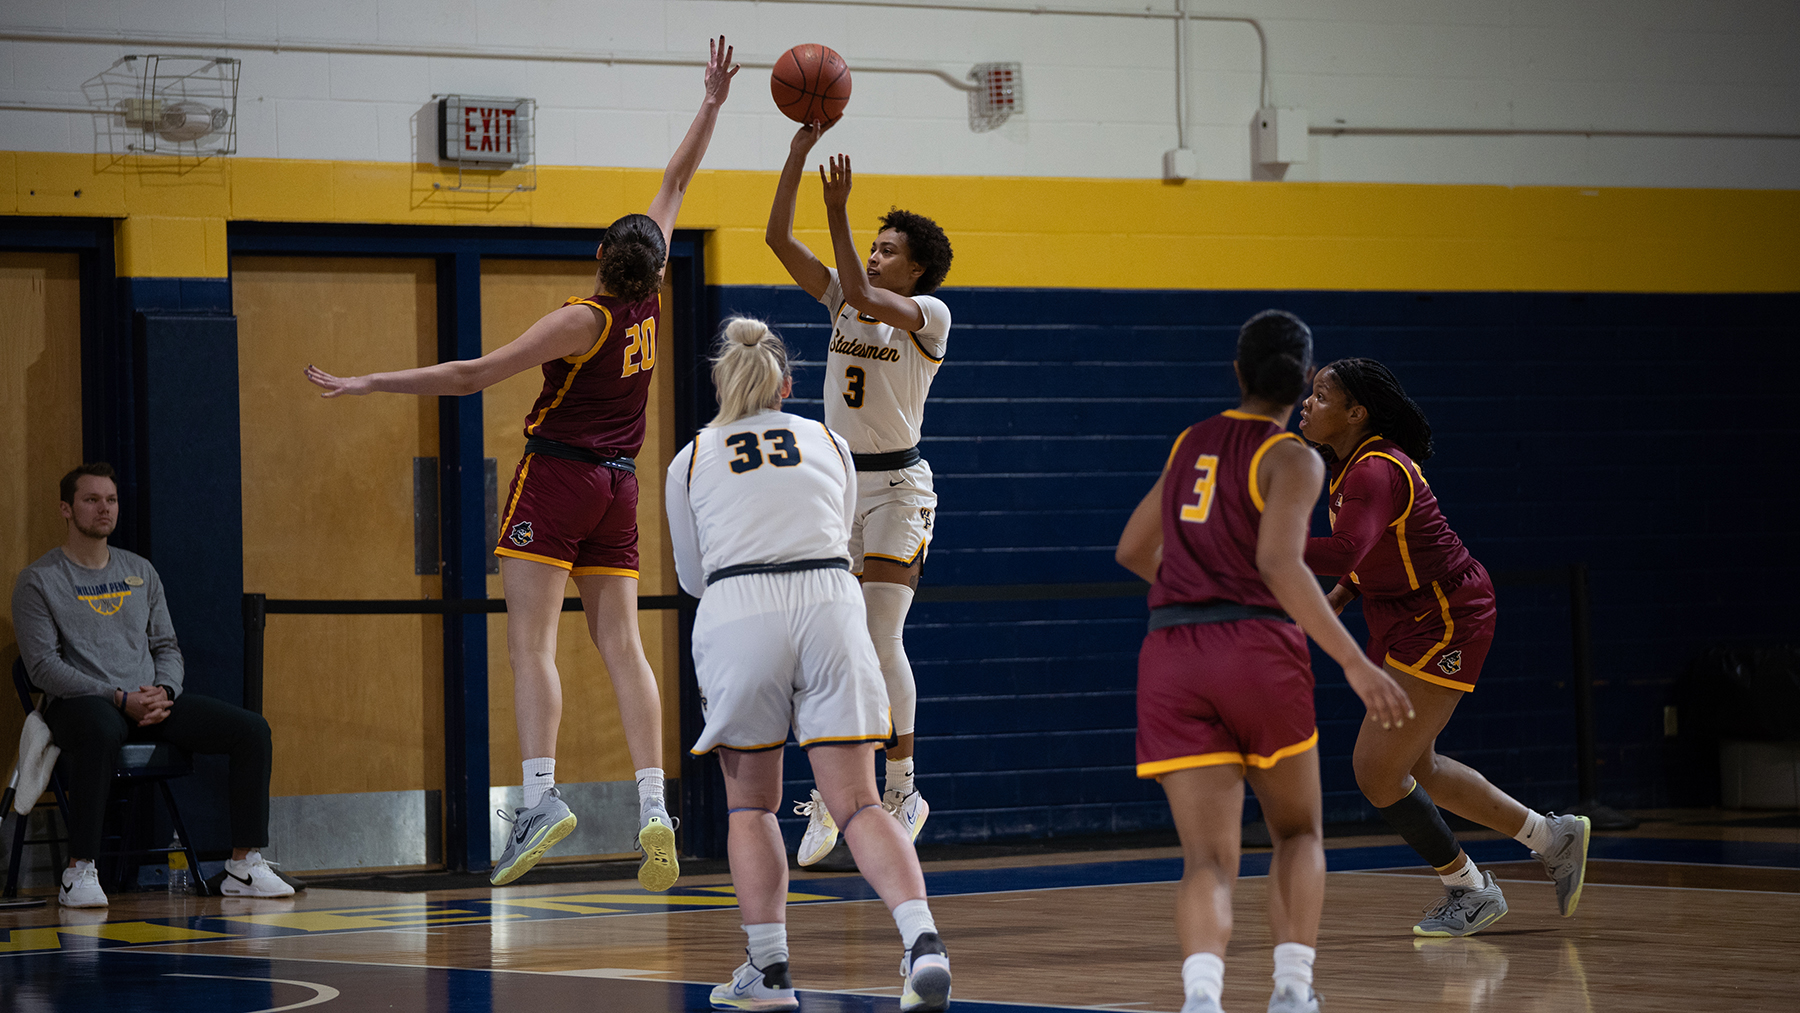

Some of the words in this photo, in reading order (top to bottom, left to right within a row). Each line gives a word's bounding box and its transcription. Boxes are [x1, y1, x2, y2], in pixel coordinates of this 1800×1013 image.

[465, 107, 516, 153] EXIT
[621, 316, 656, 378] 20
[830, 328, 900, 362] Statesmen
[842, 365, 866, 409] 3
[725, 428, 802, 475] 33
[1180, 454, 1219, 523] 3
[75, 583, 108, 596] WILLIAM
[109, 581, 130, 593] PENN
